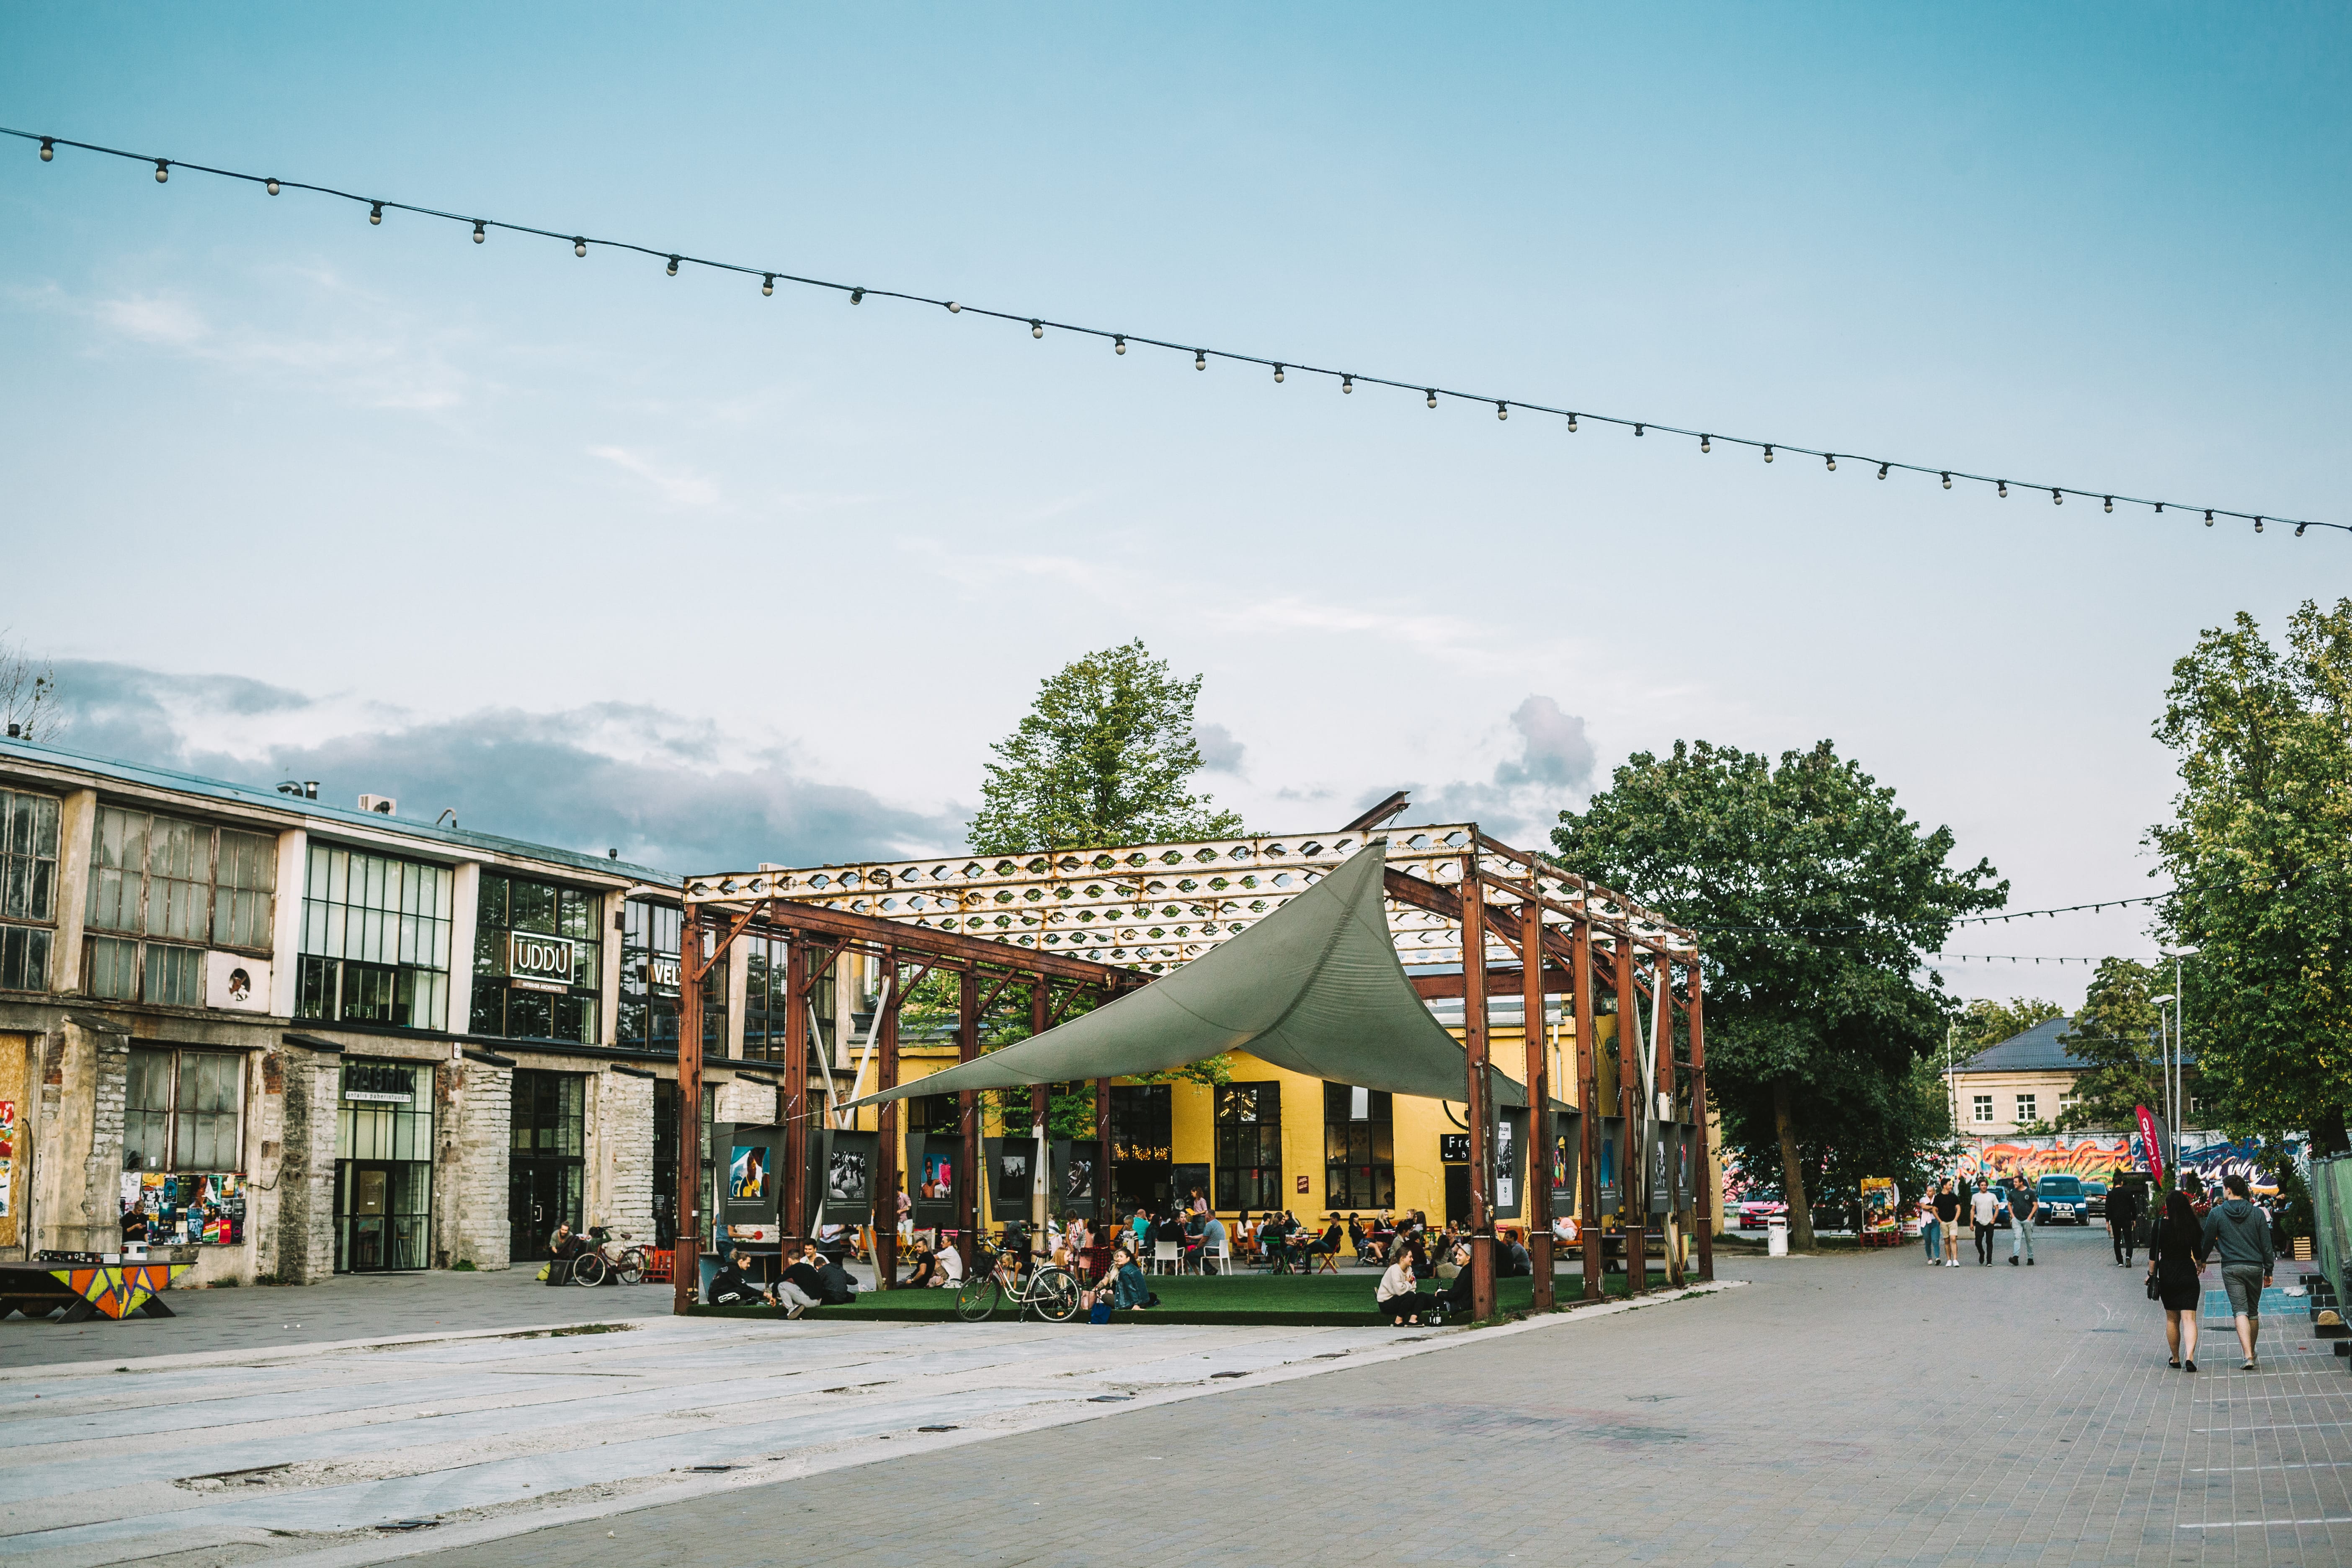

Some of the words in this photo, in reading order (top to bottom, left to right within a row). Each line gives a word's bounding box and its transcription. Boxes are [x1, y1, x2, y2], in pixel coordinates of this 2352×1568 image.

[518, 942, 567, 973] UDDU
[653, 963, 681, 986] VEL
[346, 1066, 415, 1092] PABRIK
[370, 1092, 410, 1101] paberistuudio
